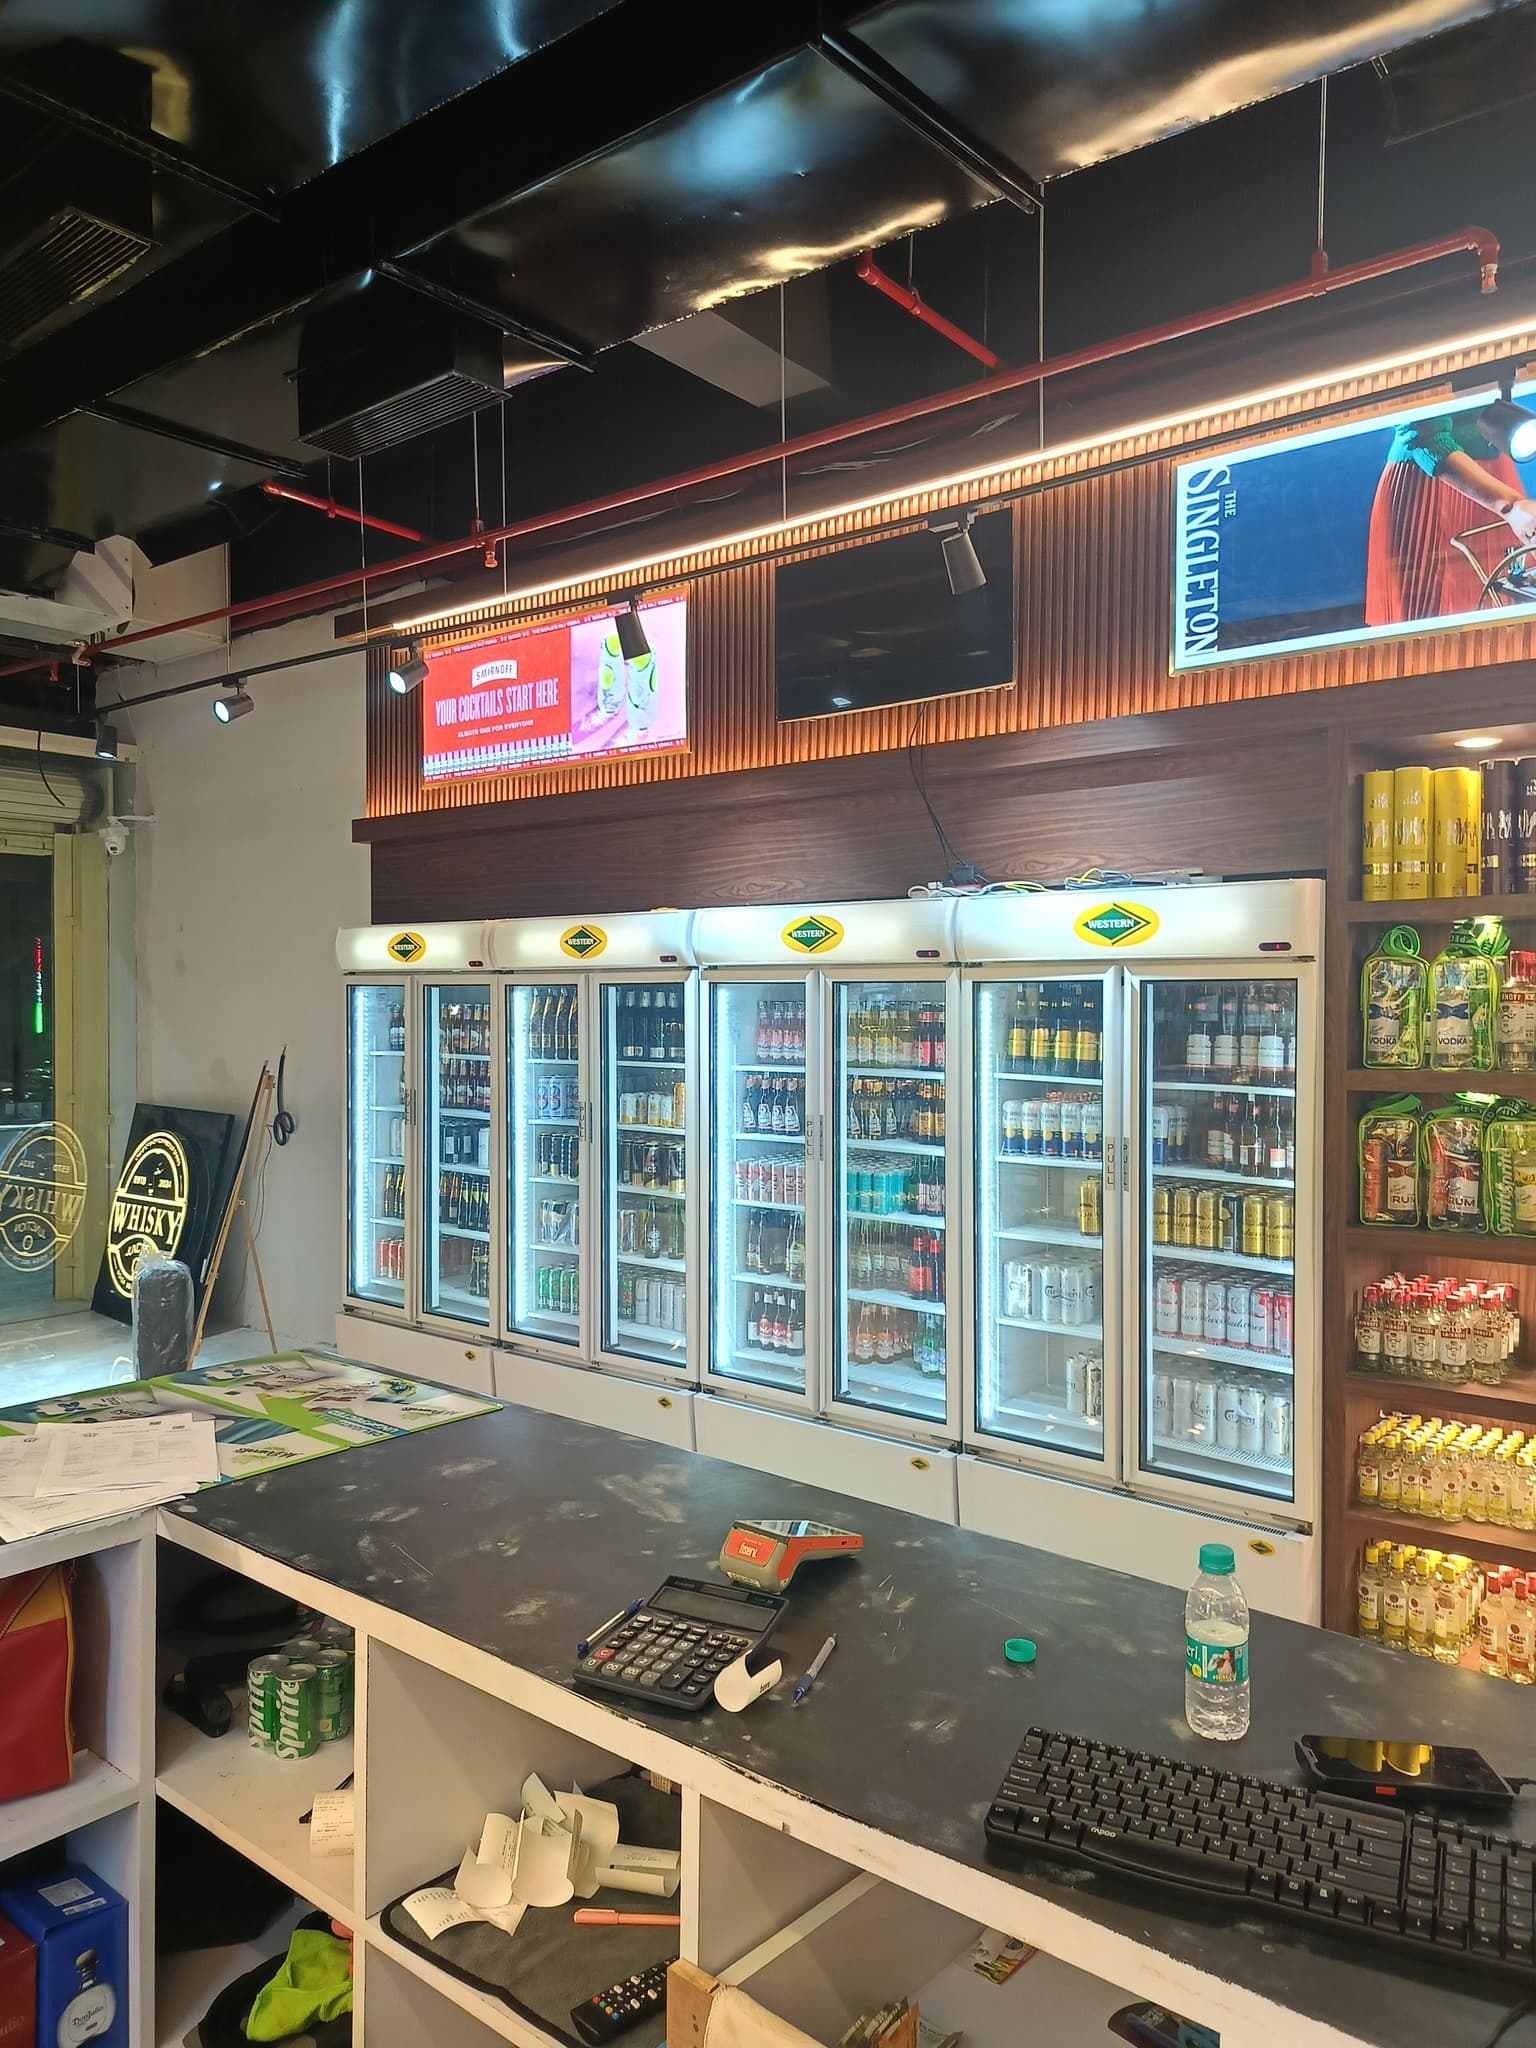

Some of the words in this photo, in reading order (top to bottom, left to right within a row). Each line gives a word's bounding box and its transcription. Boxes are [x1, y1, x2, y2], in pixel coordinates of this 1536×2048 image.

[1224, 490, 1237, 517] THE
[1185, 464, 1231, 656] SINGLETON
[475, 664, 514, 681] SMIRNOFF
[435, 697, 457, 727] YOUR
[458, 688, 503, 722] COCKTAILS
[506, 683, 534, 714] START
[535, 678, 560, 708] HERE
[457, 728, 479, 738] ALWAYS
[480, 726, 491, 734] ONE
[492, 724, 503, 733] FOR
[504, 720, 534, 730] EVERYONE
[1087, 918, 1134, 929] WESTERN
[791, 929, 826, 938] WESTERN
[1369, 1036, 1397, 1045] VODKA
[1438, 1036, 1468, 1045] VODKA
[1449, 1195, 1475, 1207] RUM
[113, 1202, 182, 1245] WHISKY
[606, 1663, 618, 1671] 00
[625, 1667, 638, 1676] 000
[274, 1680, 305, 1760] Sprite
[1091, 1826, 1116, 1838] rapoo
